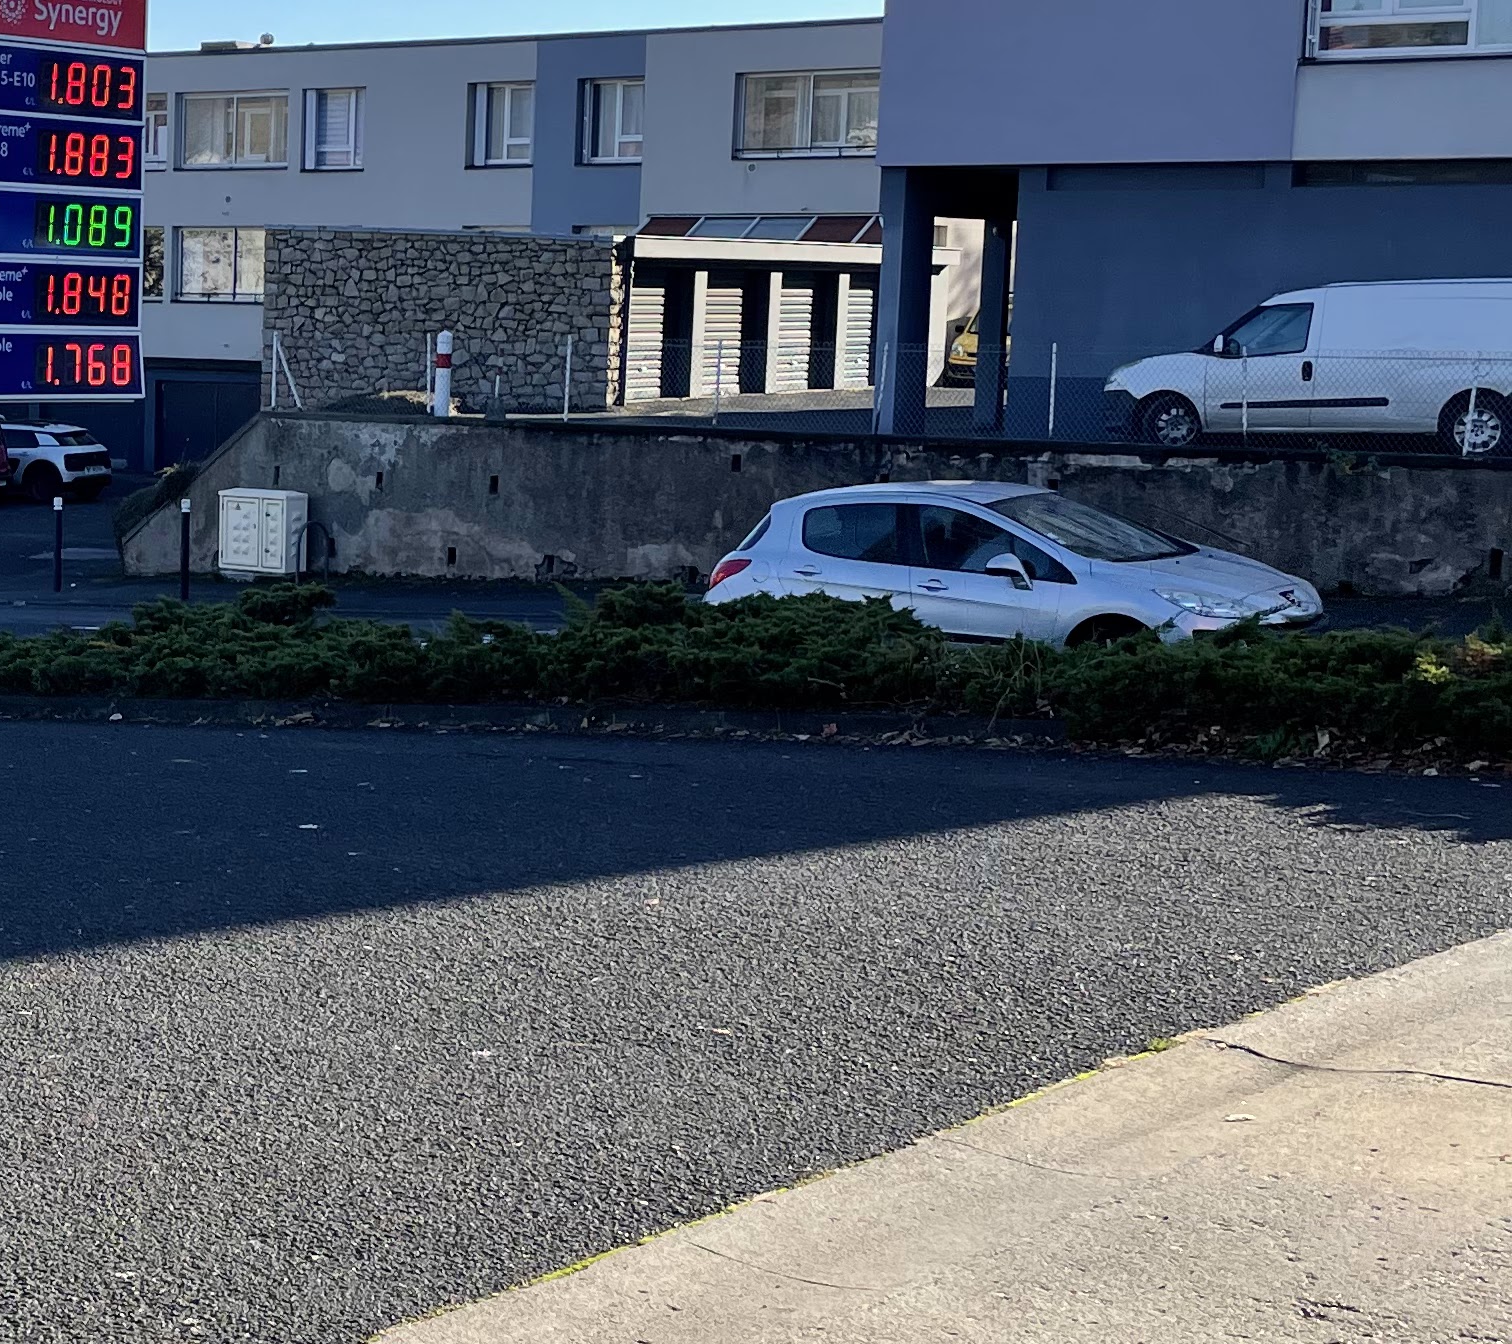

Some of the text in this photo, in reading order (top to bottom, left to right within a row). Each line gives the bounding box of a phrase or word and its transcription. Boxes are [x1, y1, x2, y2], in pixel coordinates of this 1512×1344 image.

[50, 62, 136, 109] 1.803
[49, 132, 134, 179] 1.883
[48, 204, 132, 247] 1.089
[45, 343, 131, 386] 1.768
